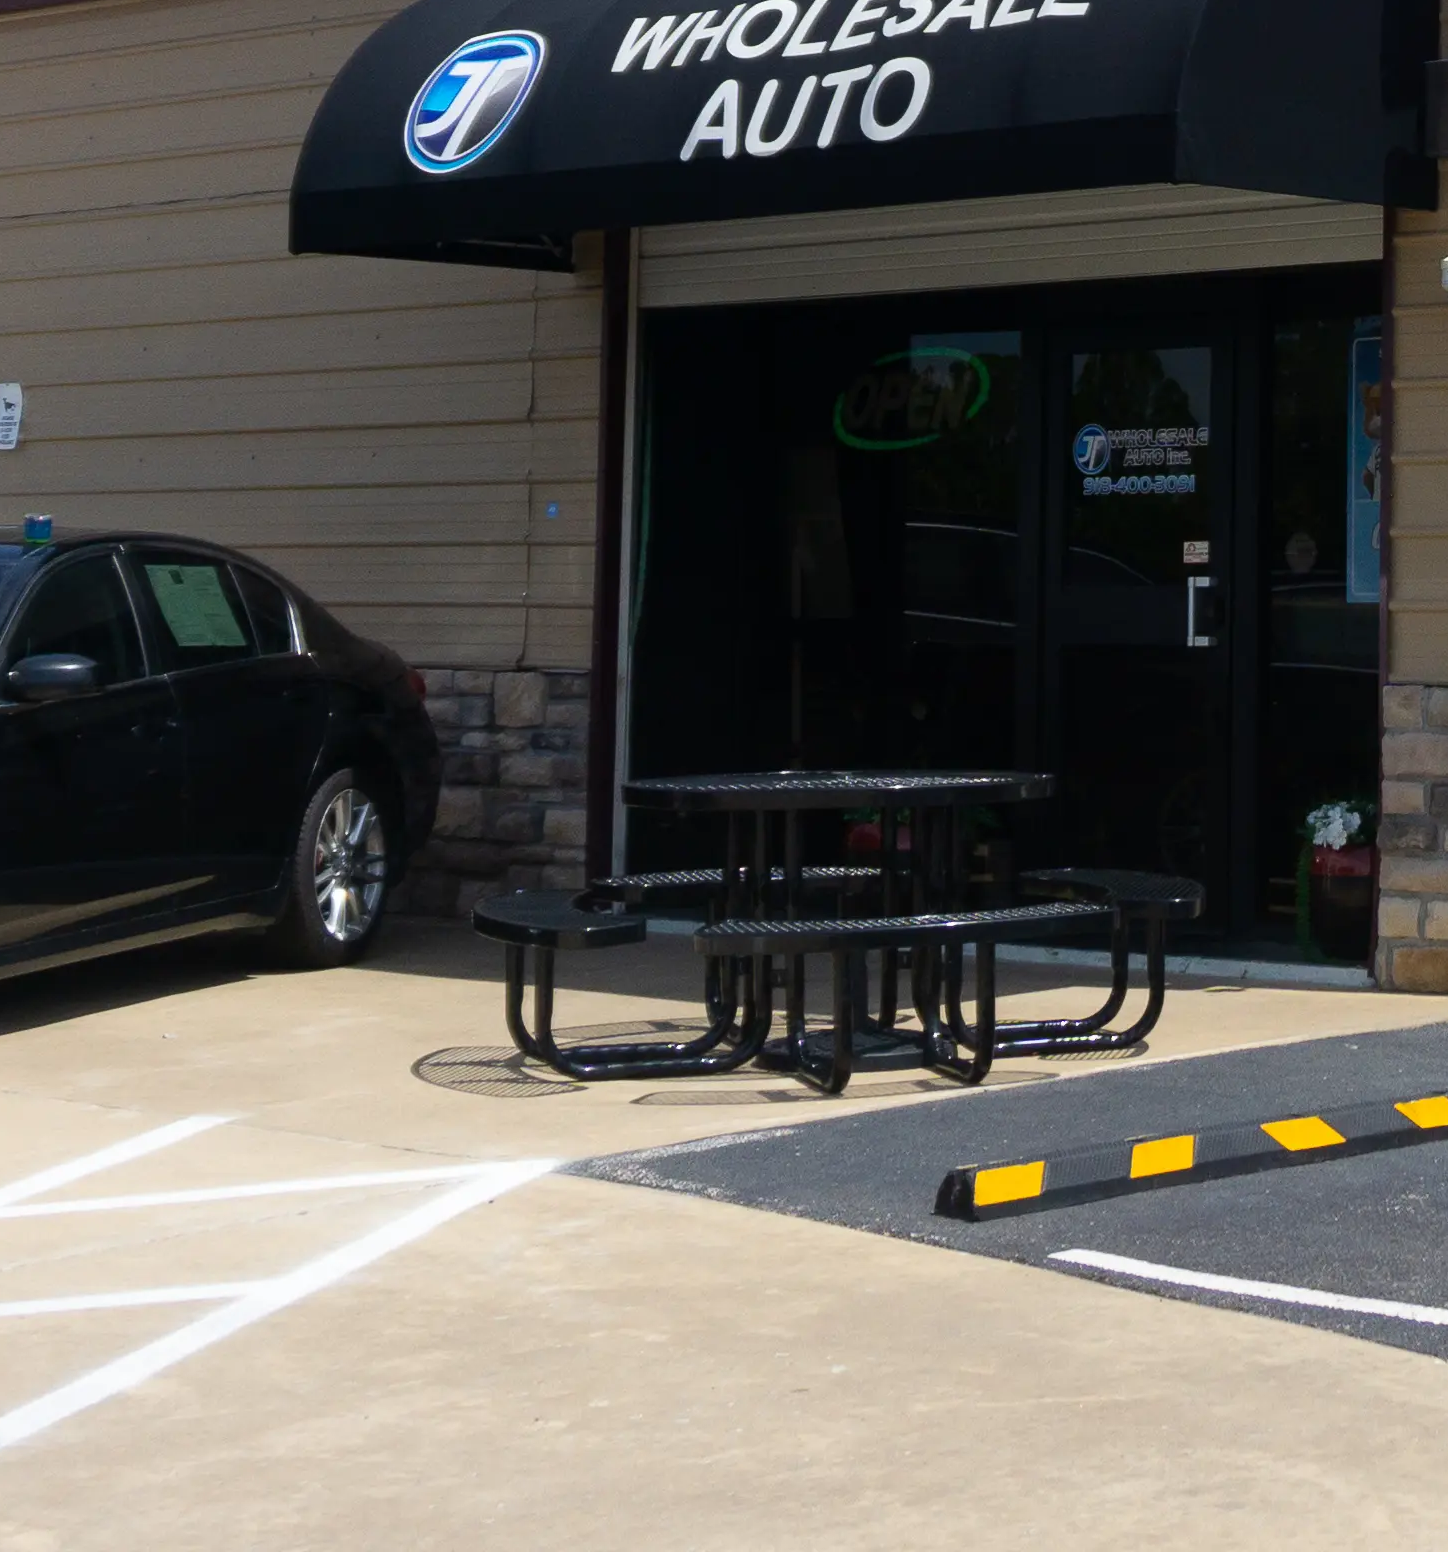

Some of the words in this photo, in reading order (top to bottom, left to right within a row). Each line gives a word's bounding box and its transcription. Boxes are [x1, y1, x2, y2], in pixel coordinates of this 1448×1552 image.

[679, 56, 932, 162] AUTO
[844, 362, 973, 431] OPEN
[1107, 427, 1210, 449] WHOLESALE
[1122, 447, 1165, 467] AUTO
[1166, 447, 1192, 466] Inc.
[1082, 474, 1197, 496] 918-400-3091
